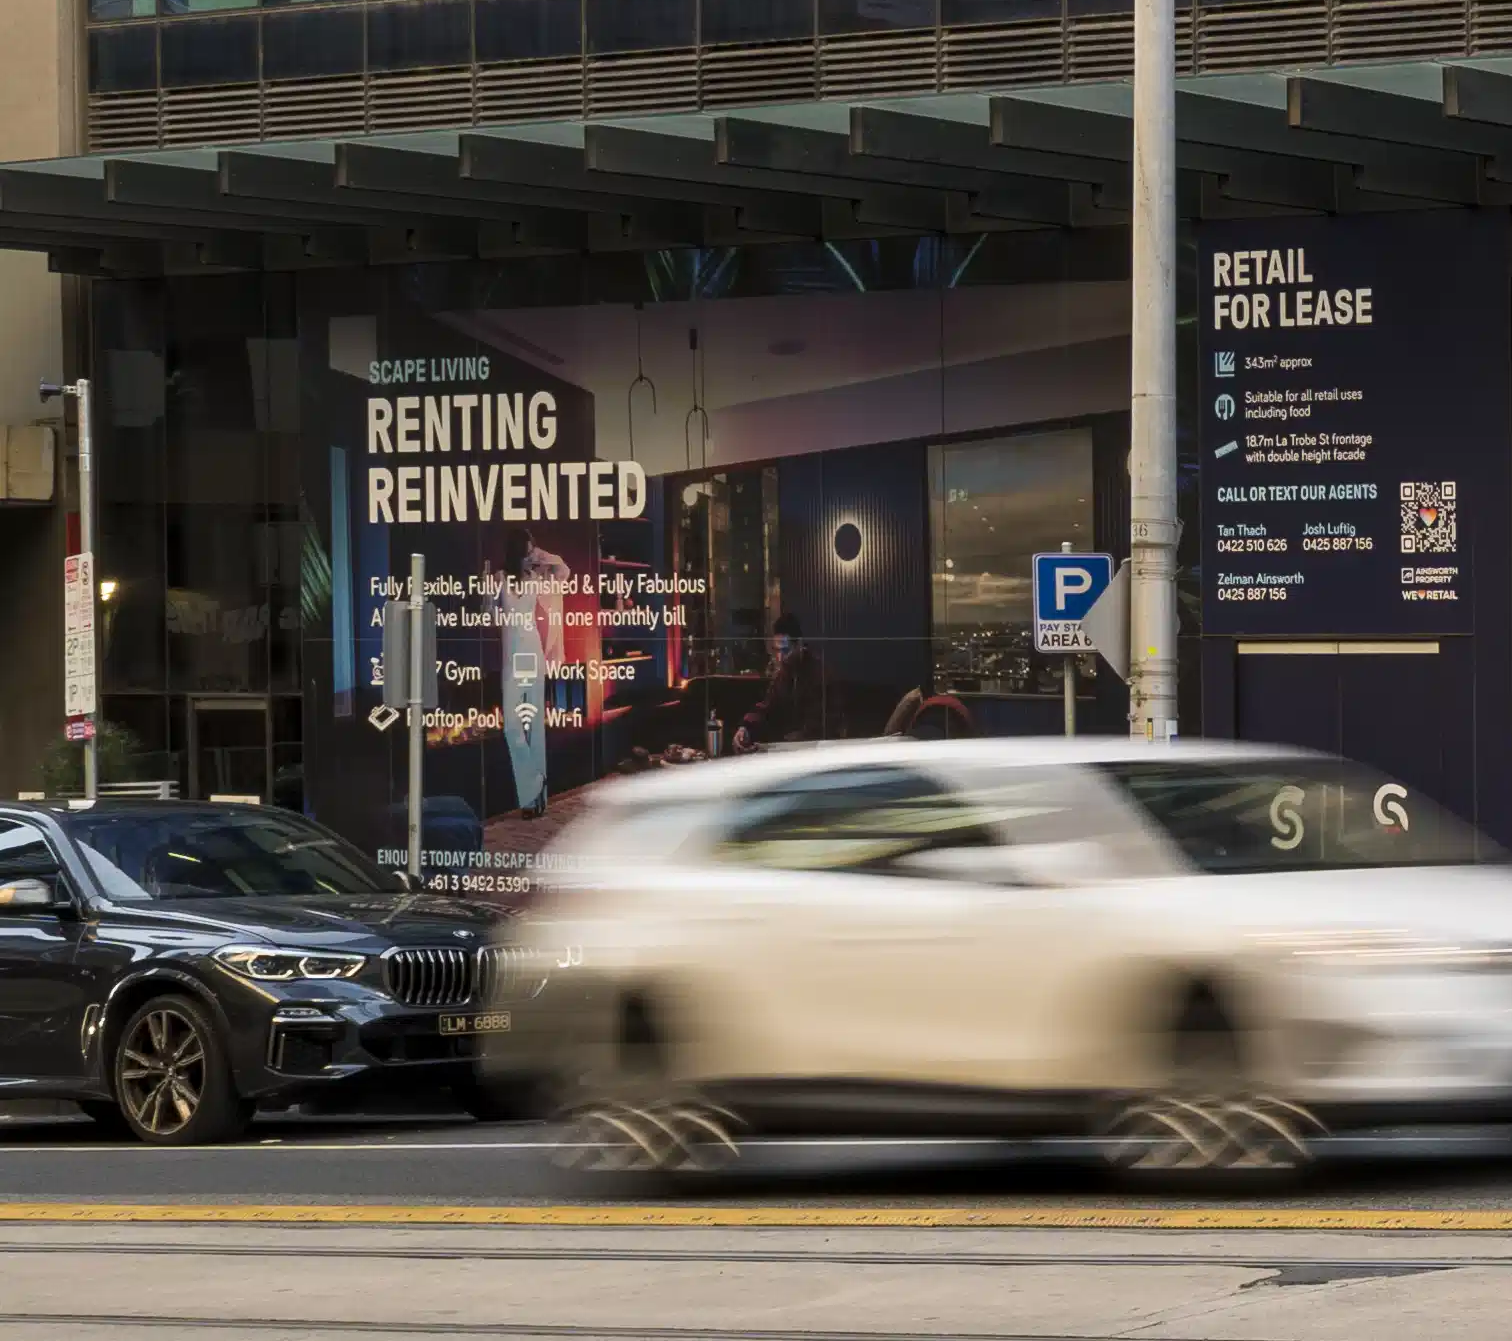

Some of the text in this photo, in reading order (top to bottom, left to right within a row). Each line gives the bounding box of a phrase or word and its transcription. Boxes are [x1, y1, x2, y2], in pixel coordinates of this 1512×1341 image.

[1213, 248, 1313, 287] RETAIL
[1214, 288, 1373, 330] FOR LEASE
[369, 356, 490, 384] SCAPE LIVING
[1280, 357, 1313, 370] approx
[1245, 388, 1363, 403] Suitable for all retail uses
[1245, 405, 1311, 420] including food
[367, 391, 557, 454] RENTING
[1245, 432, 1373, 448] 18.7m La Trobe St frontage
[1245, 448, 1366, 464] with double height facade
[368, 460, 647, 524] REINVENTED
[1217, 483, 1378, 502] CALL OR TEXT OUR AGENTS
[1217, 523, 1267, 537] Tan Thach
[1302, 522, 1356, 537] Josh Luftig
[1217, 538, 1288, 553] 0422 510 626
[1303, 537, 1373, 551] 0425 887 156
[371, 572, 706, 600] Fully Fexible, Fully Furnished & Fully Fabulous
[1217, 571, 1304, 585] Zelman Ainsworth
[1415, 576, 1452, 584] PROPERTY
[1055, 567, 1093, 611] P
[1218, 587, 1287, 601] 0425 887 156
[1401, 590, 1458, 600] WE RETAIL
[461, 607, 491, 626] luxe
[494, 606, 534, 631] living
[548, 607, 563, 626] in
[565, 609, 593, 627] one
[597, 606, 658, 632] monthly
[663, 605, 687, 626] bill
[1040, 623, 1060, 633] PAY
[1041, 634, 1081, 647] AREA
[444, 661, 481, 685] Gym
[546, 660, 585, 680] Work
[588, 660, 636, 685] Space
[468, 707, 583, 728] Pool Wi-fi
[377, 848, 428, 866] ENQUE
[429, 849, 467, 867] TODAY
[469, 851, 492, 868] FOR
[493, 852, 533, 869] SCAPE
[428, 874, 448, 890] +61
[451, 875, 459, 891] 3
[463, 875, 494, 892] 9492
[496, 876, 530, 893] 5390
